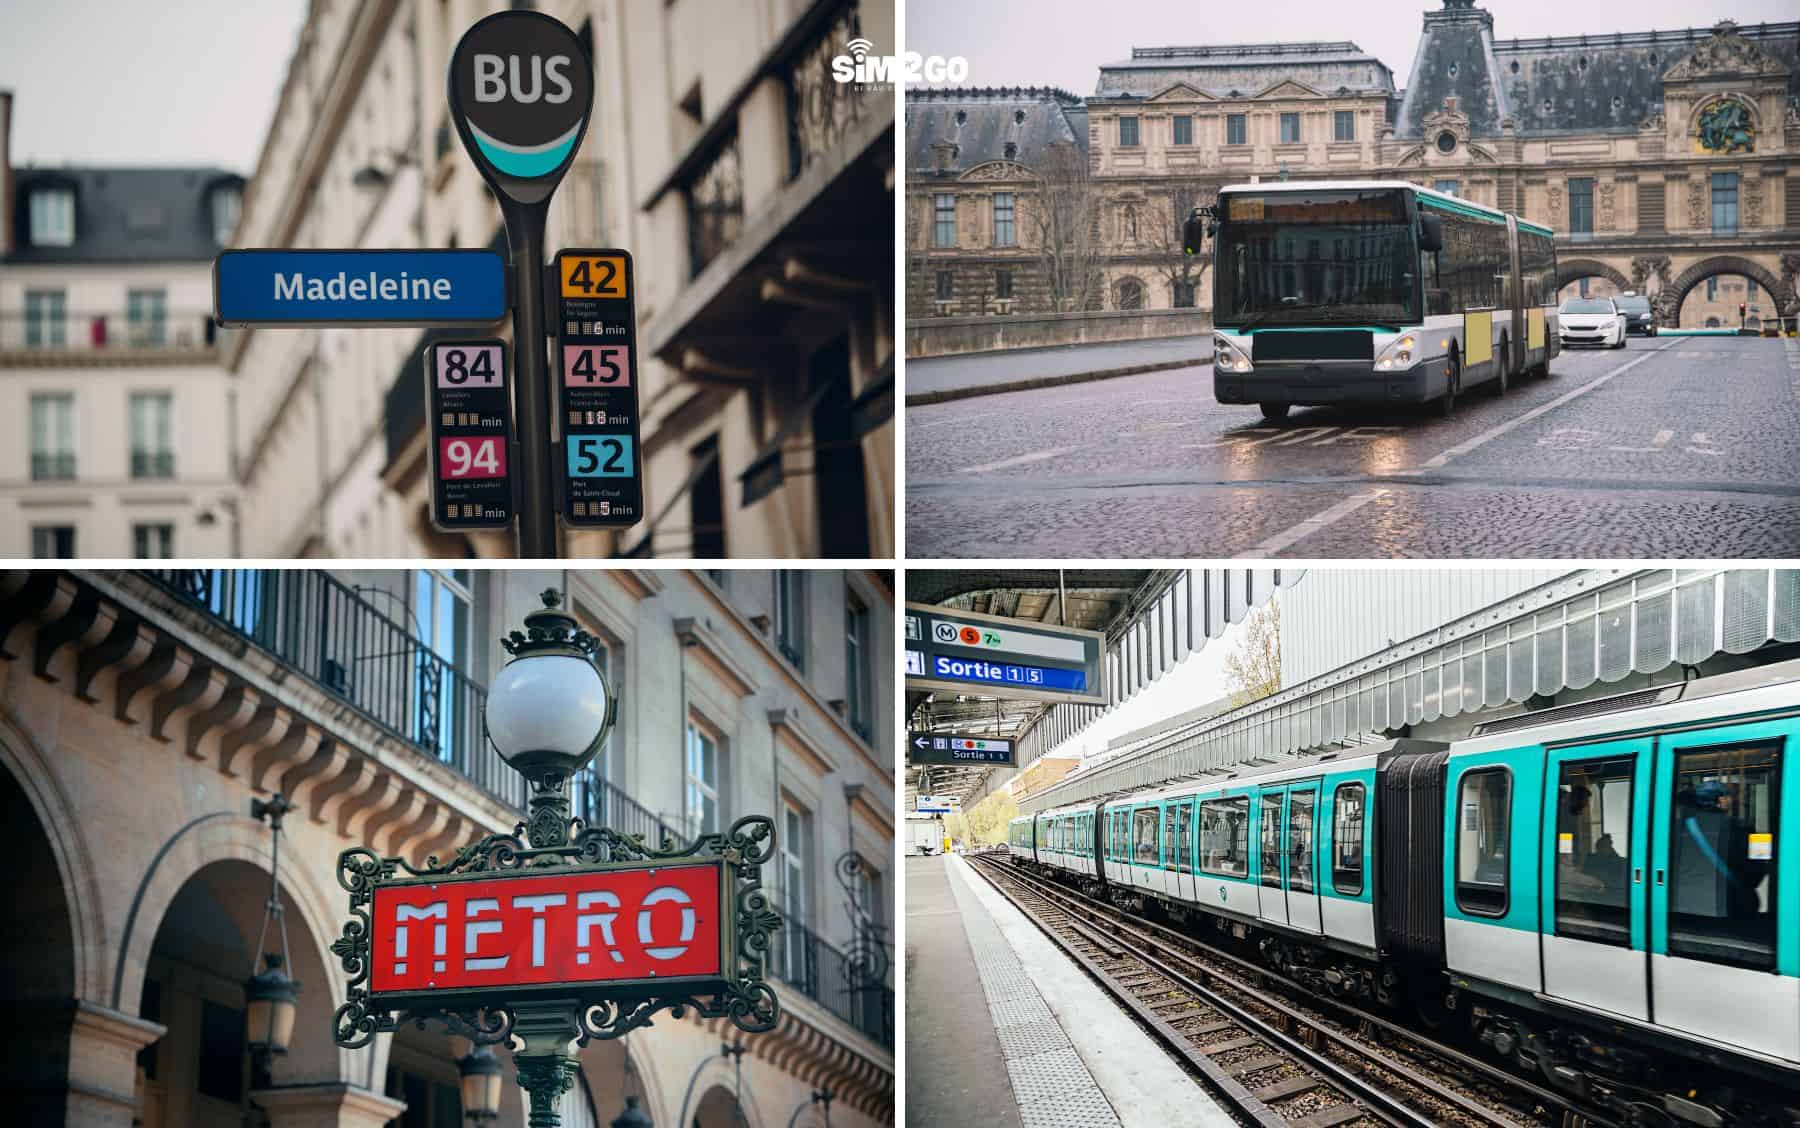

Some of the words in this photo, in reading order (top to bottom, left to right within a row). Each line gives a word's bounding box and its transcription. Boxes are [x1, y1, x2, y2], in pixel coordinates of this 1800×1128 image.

[474, 54, 573, 104] BUS
[274, 272, 451, 301] Madeleine
[568, 260, 618, 294] 42
[605, 324, 626, 335] min
[445, 349, 495, 384] 84
[571, 349, 621, 383] 45
[481, 416, 502, 427] min
[608, 415, 629, 425] min
[447, 440, 499, 476] 94
[577, 438, 625, 474] 52
[484, 507, 506, 518] min
[612, 505, 633, 515] min
[937, 657, 1002, 680] Sortie
[953, 750, 985, 760] Sortie
[394, 887, 696, 976] METRO
